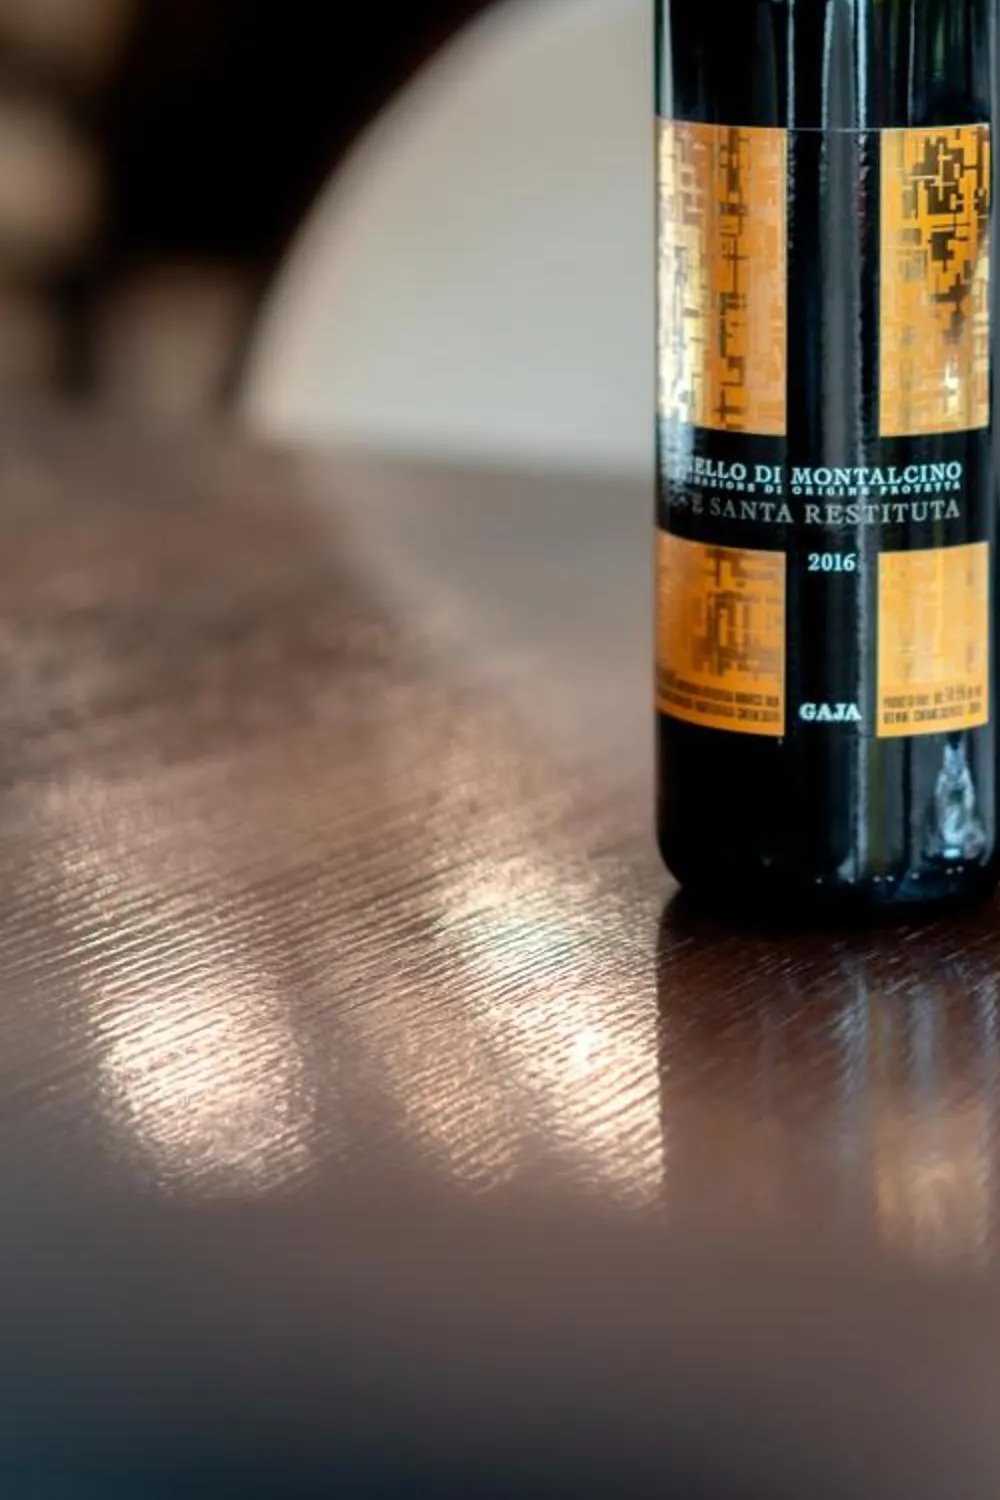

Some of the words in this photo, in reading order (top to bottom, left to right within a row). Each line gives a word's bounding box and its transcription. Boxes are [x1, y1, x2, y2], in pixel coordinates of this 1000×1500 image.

[671, 455, 748, 482] ELLO
[754, 465, 783, 484] DI
[790, 460, 963, 486] MONTALCINO
[709, 497, 795, 524] SANTA
[803, 499, 961, 525] RESTITUTA
[807, 553, 857, 572] 2016
[799, 703, 862, 722] GAJA
